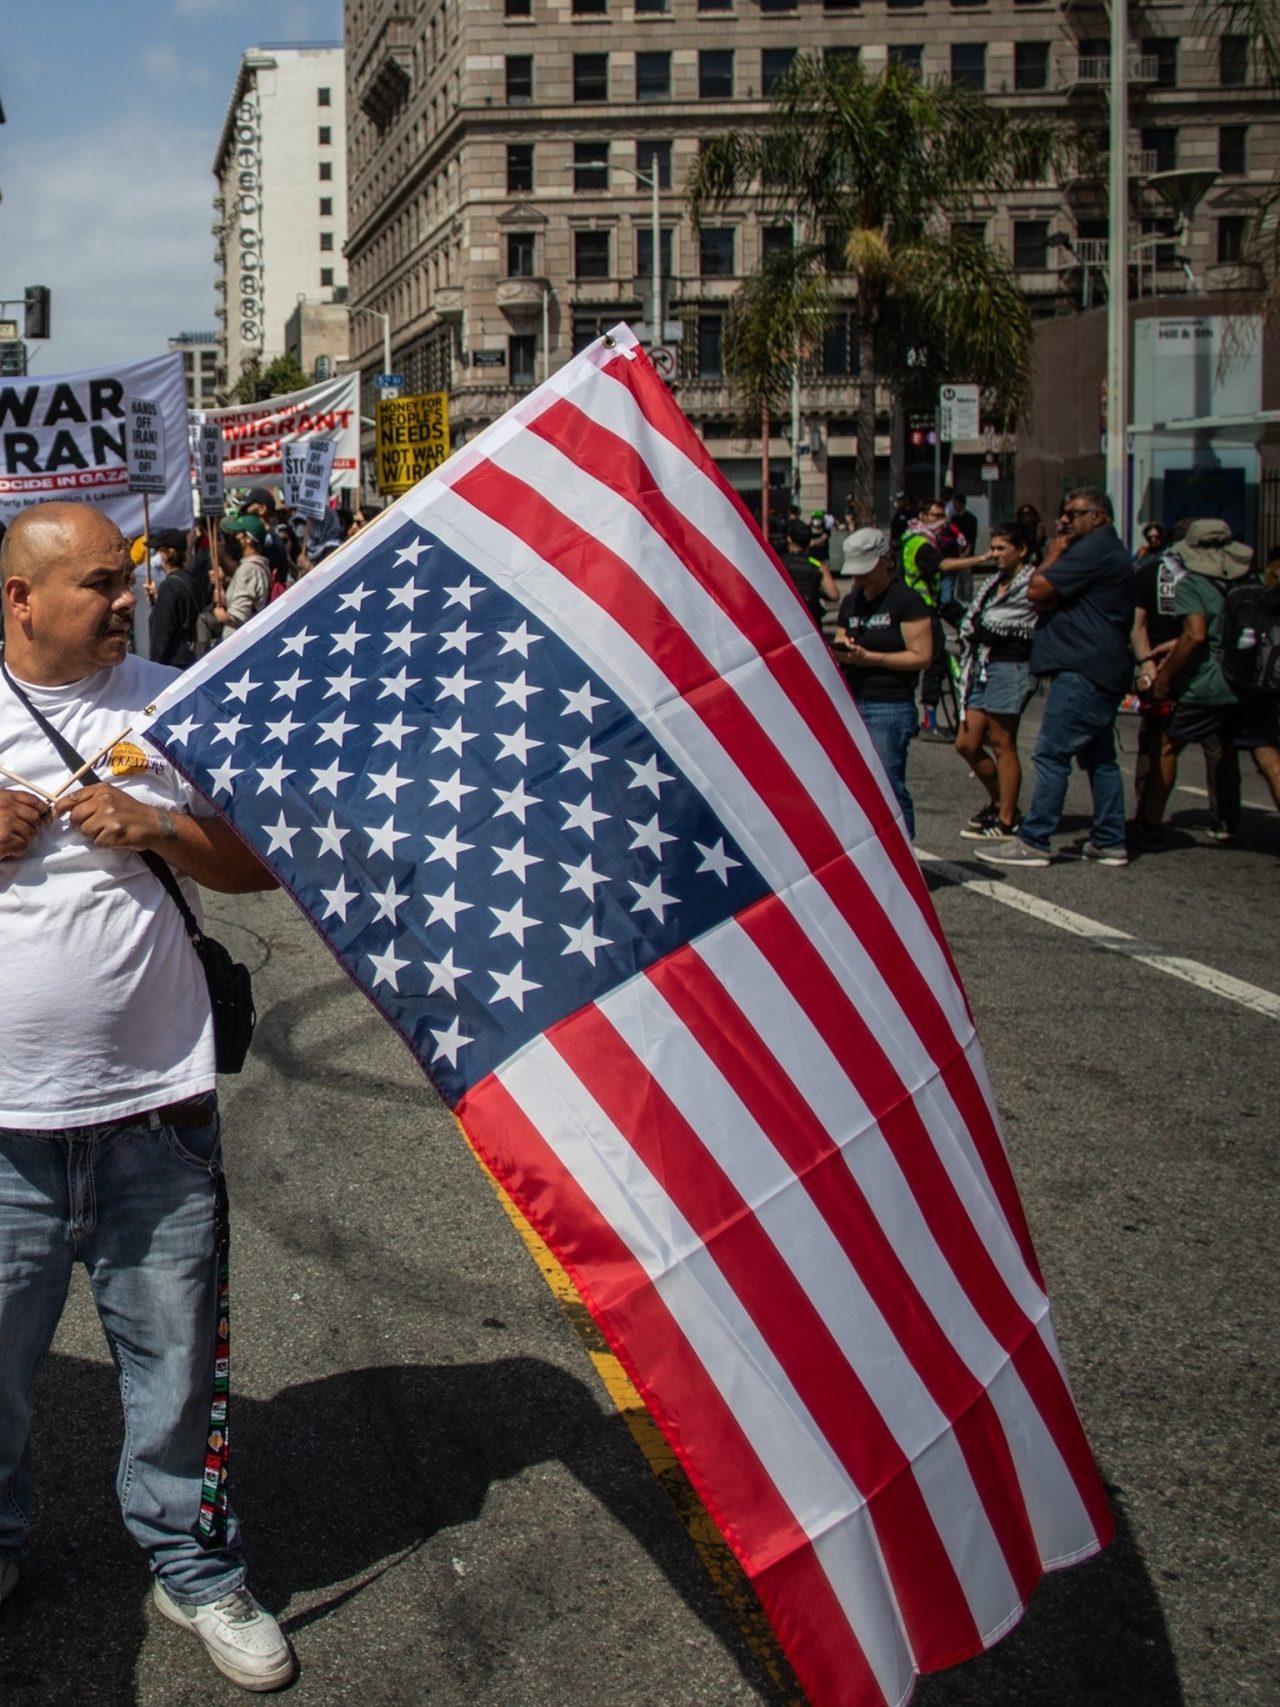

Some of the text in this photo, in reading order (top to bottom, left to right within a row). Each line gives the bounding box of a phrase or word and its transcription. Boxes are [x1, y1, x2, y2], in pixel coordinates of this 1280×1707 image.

[131, 401, 157, 415] HANDS
[380, 397, 442, 413] MONEY FOR
[136, 416, 151, 429] OFF
[213, 409, 271, 424] UNITED
[380, 408, 443, 426] PEOPLE'S
[223, 409, 354, 441] MIGRANT
[132, 430, 158, 444] IRAN!
[381, 421, 444, 446] NEEDS
[134, 449, 156, 461] HANDS
[381, 444, 445, 465] NOT WAR
[138, 461, 152, 472] OFF
[57, 475, 76, 486] IN
[79, 471, 128, 484] GAZA
